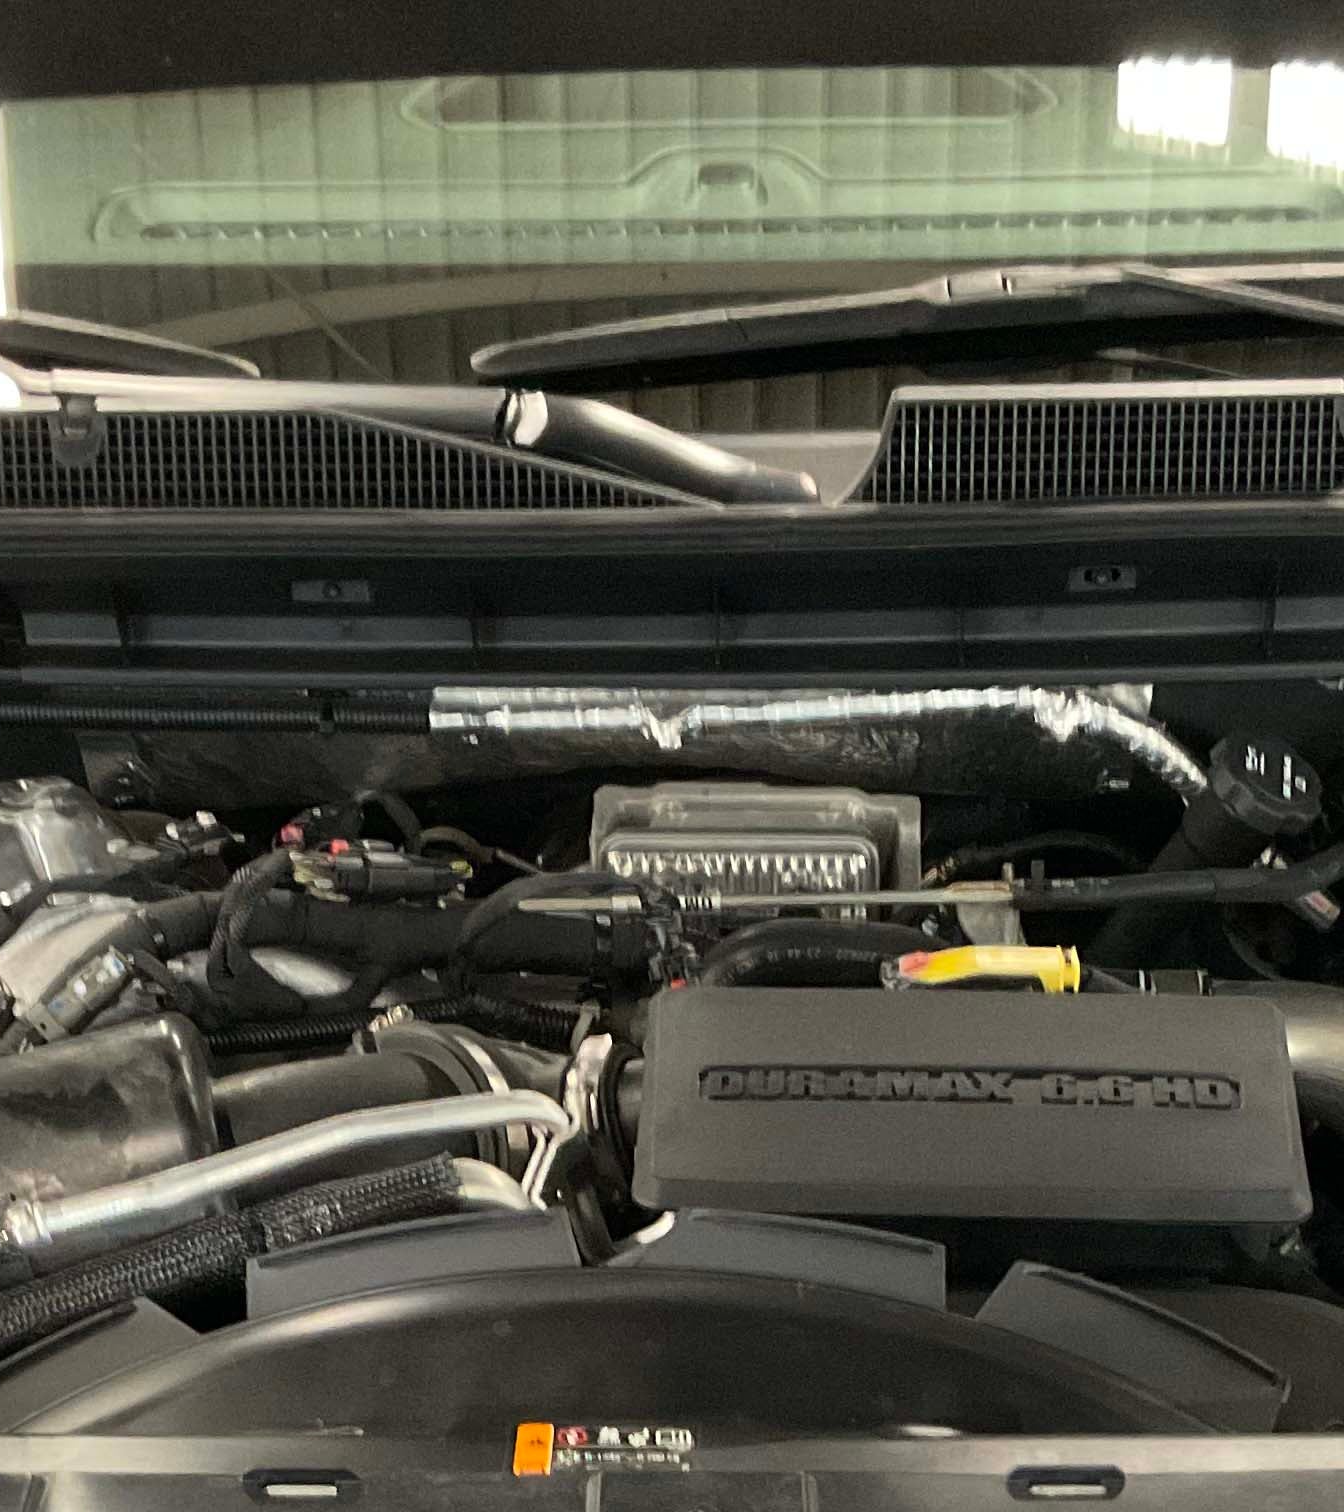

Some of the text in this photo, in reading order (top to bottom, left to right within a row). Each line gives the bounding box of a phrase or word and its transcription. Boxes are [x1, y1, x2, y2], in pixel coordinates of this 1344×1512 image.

[706, 1066, 1238, 1110] DURAMAX 6.6 HD
